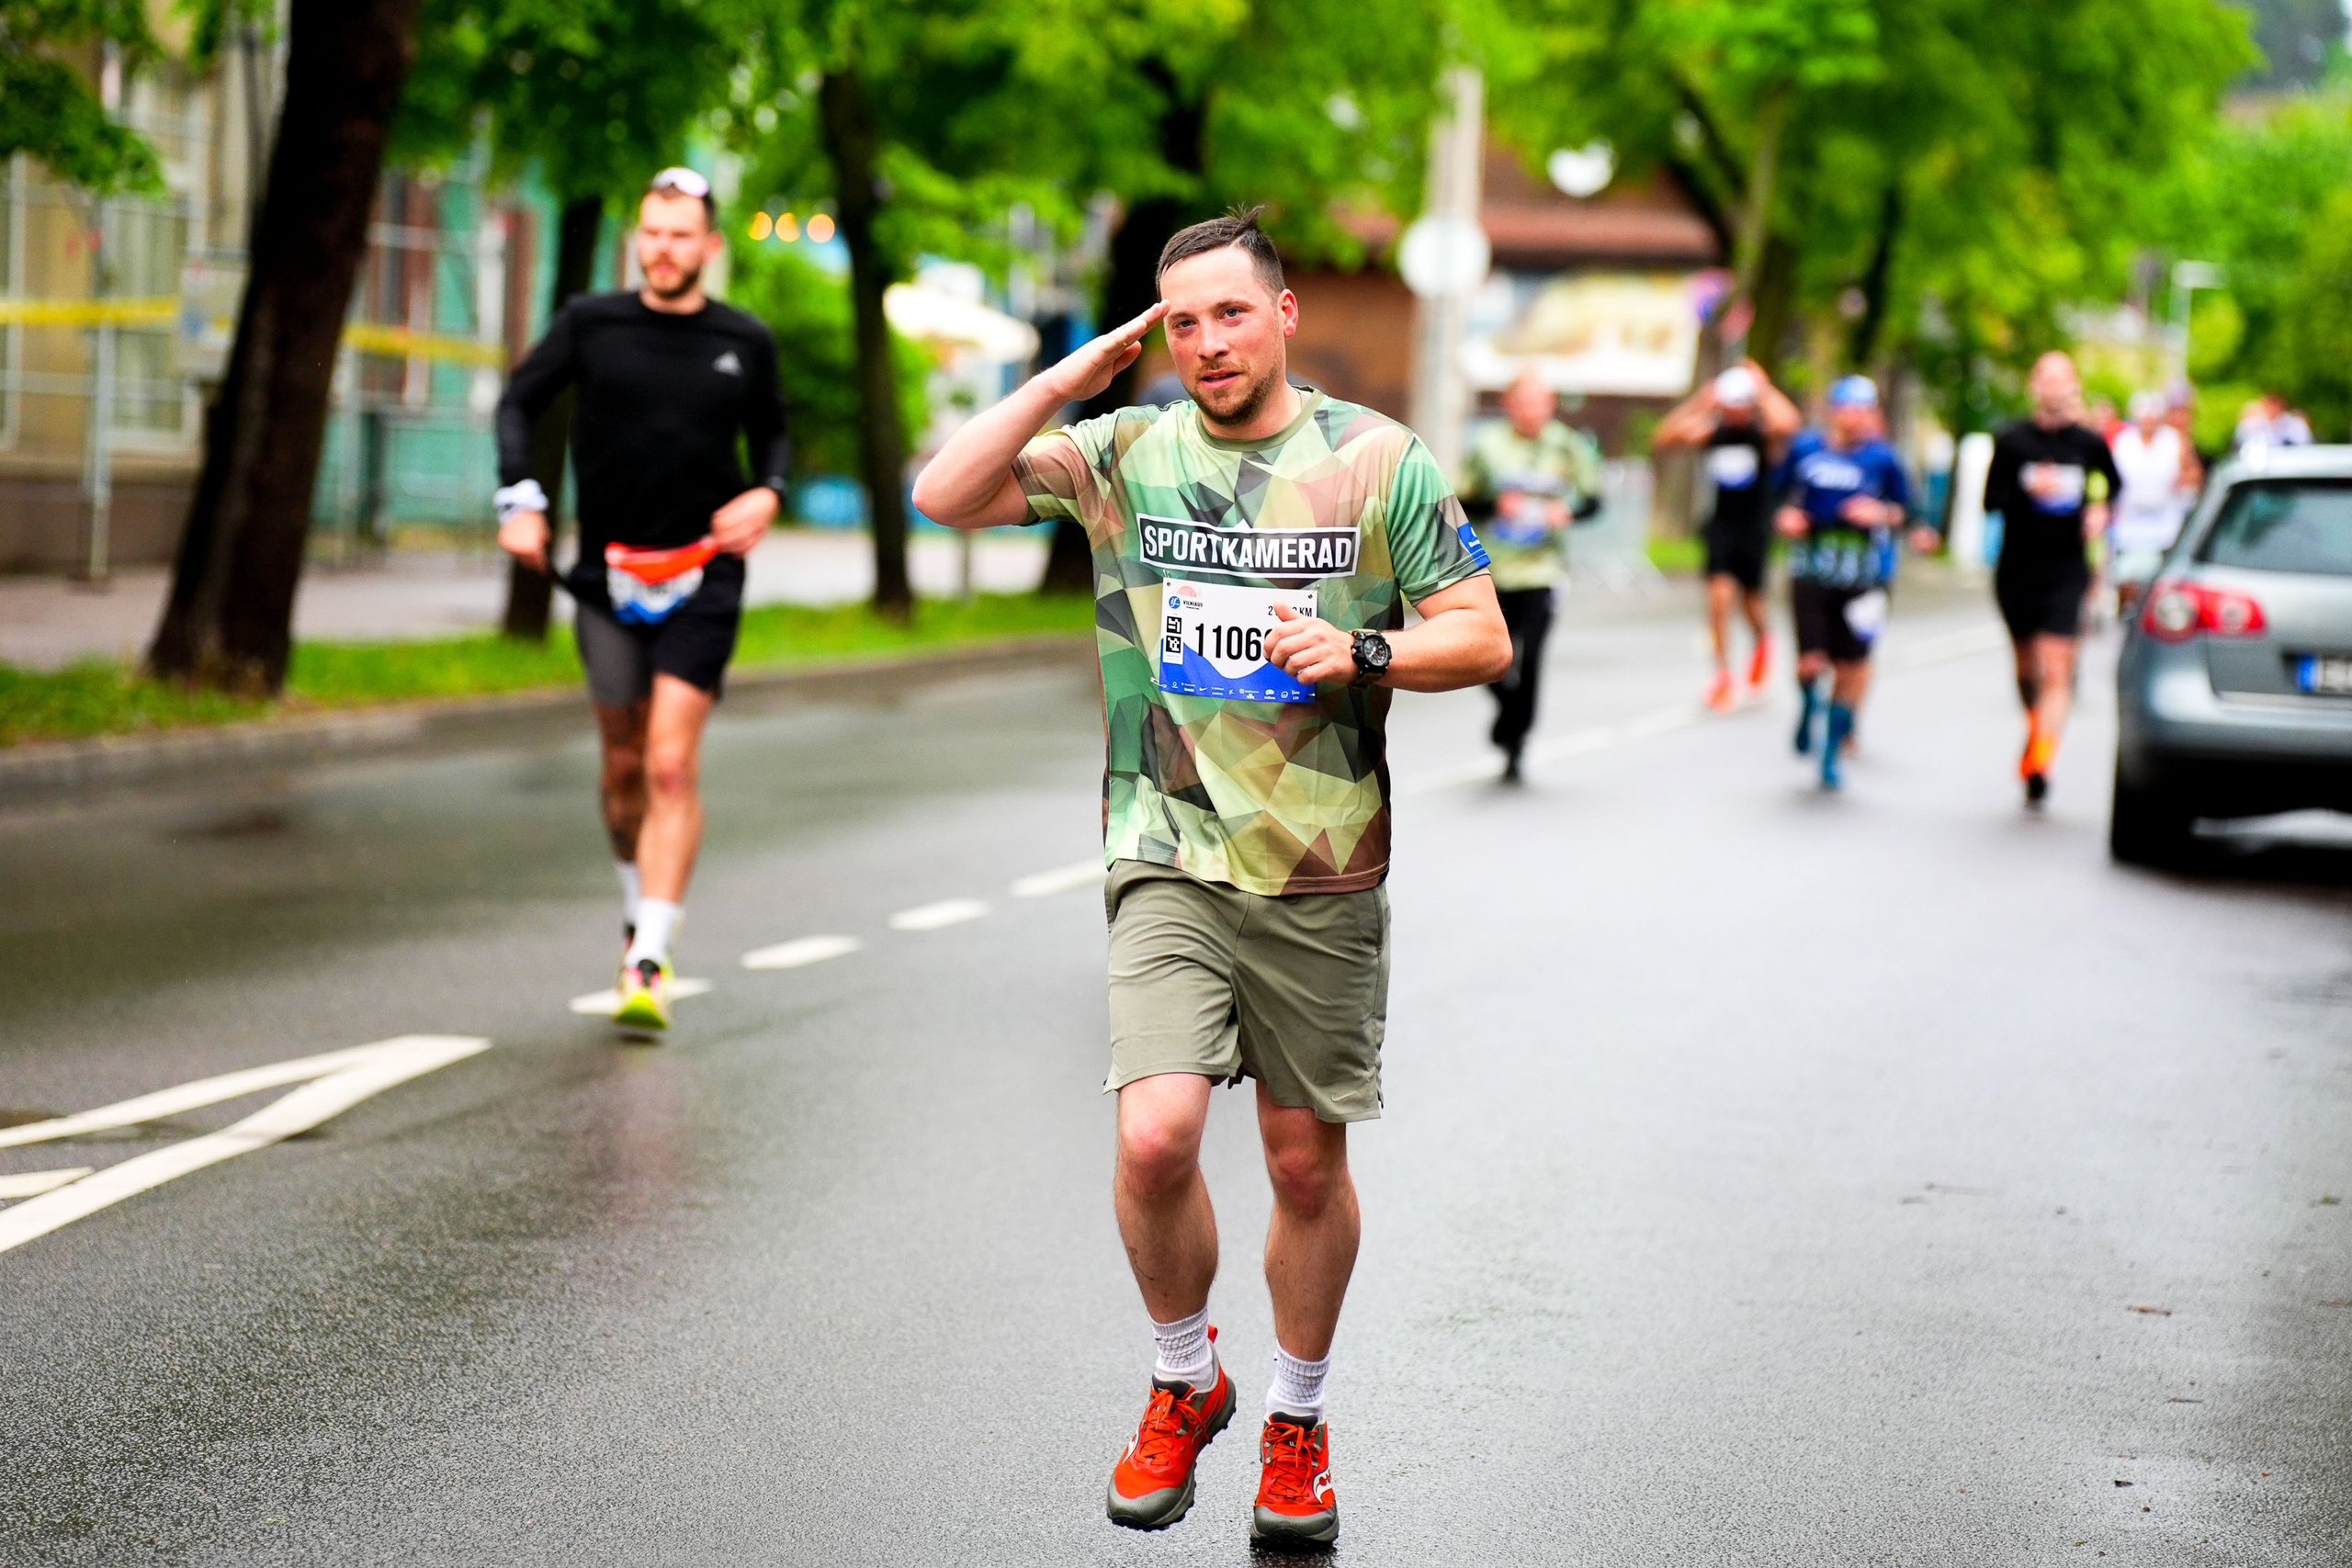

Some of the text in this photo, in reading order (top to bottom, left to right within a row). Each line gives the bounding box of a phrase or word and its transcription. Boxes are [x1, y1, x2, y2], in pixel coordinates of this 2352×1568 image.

[1144, 525, 1352, 569] SPORTKAMERAD
[1182, 600, 1204, 608] VILNIAUS
[1195, 623, 1273, 662] 1106
